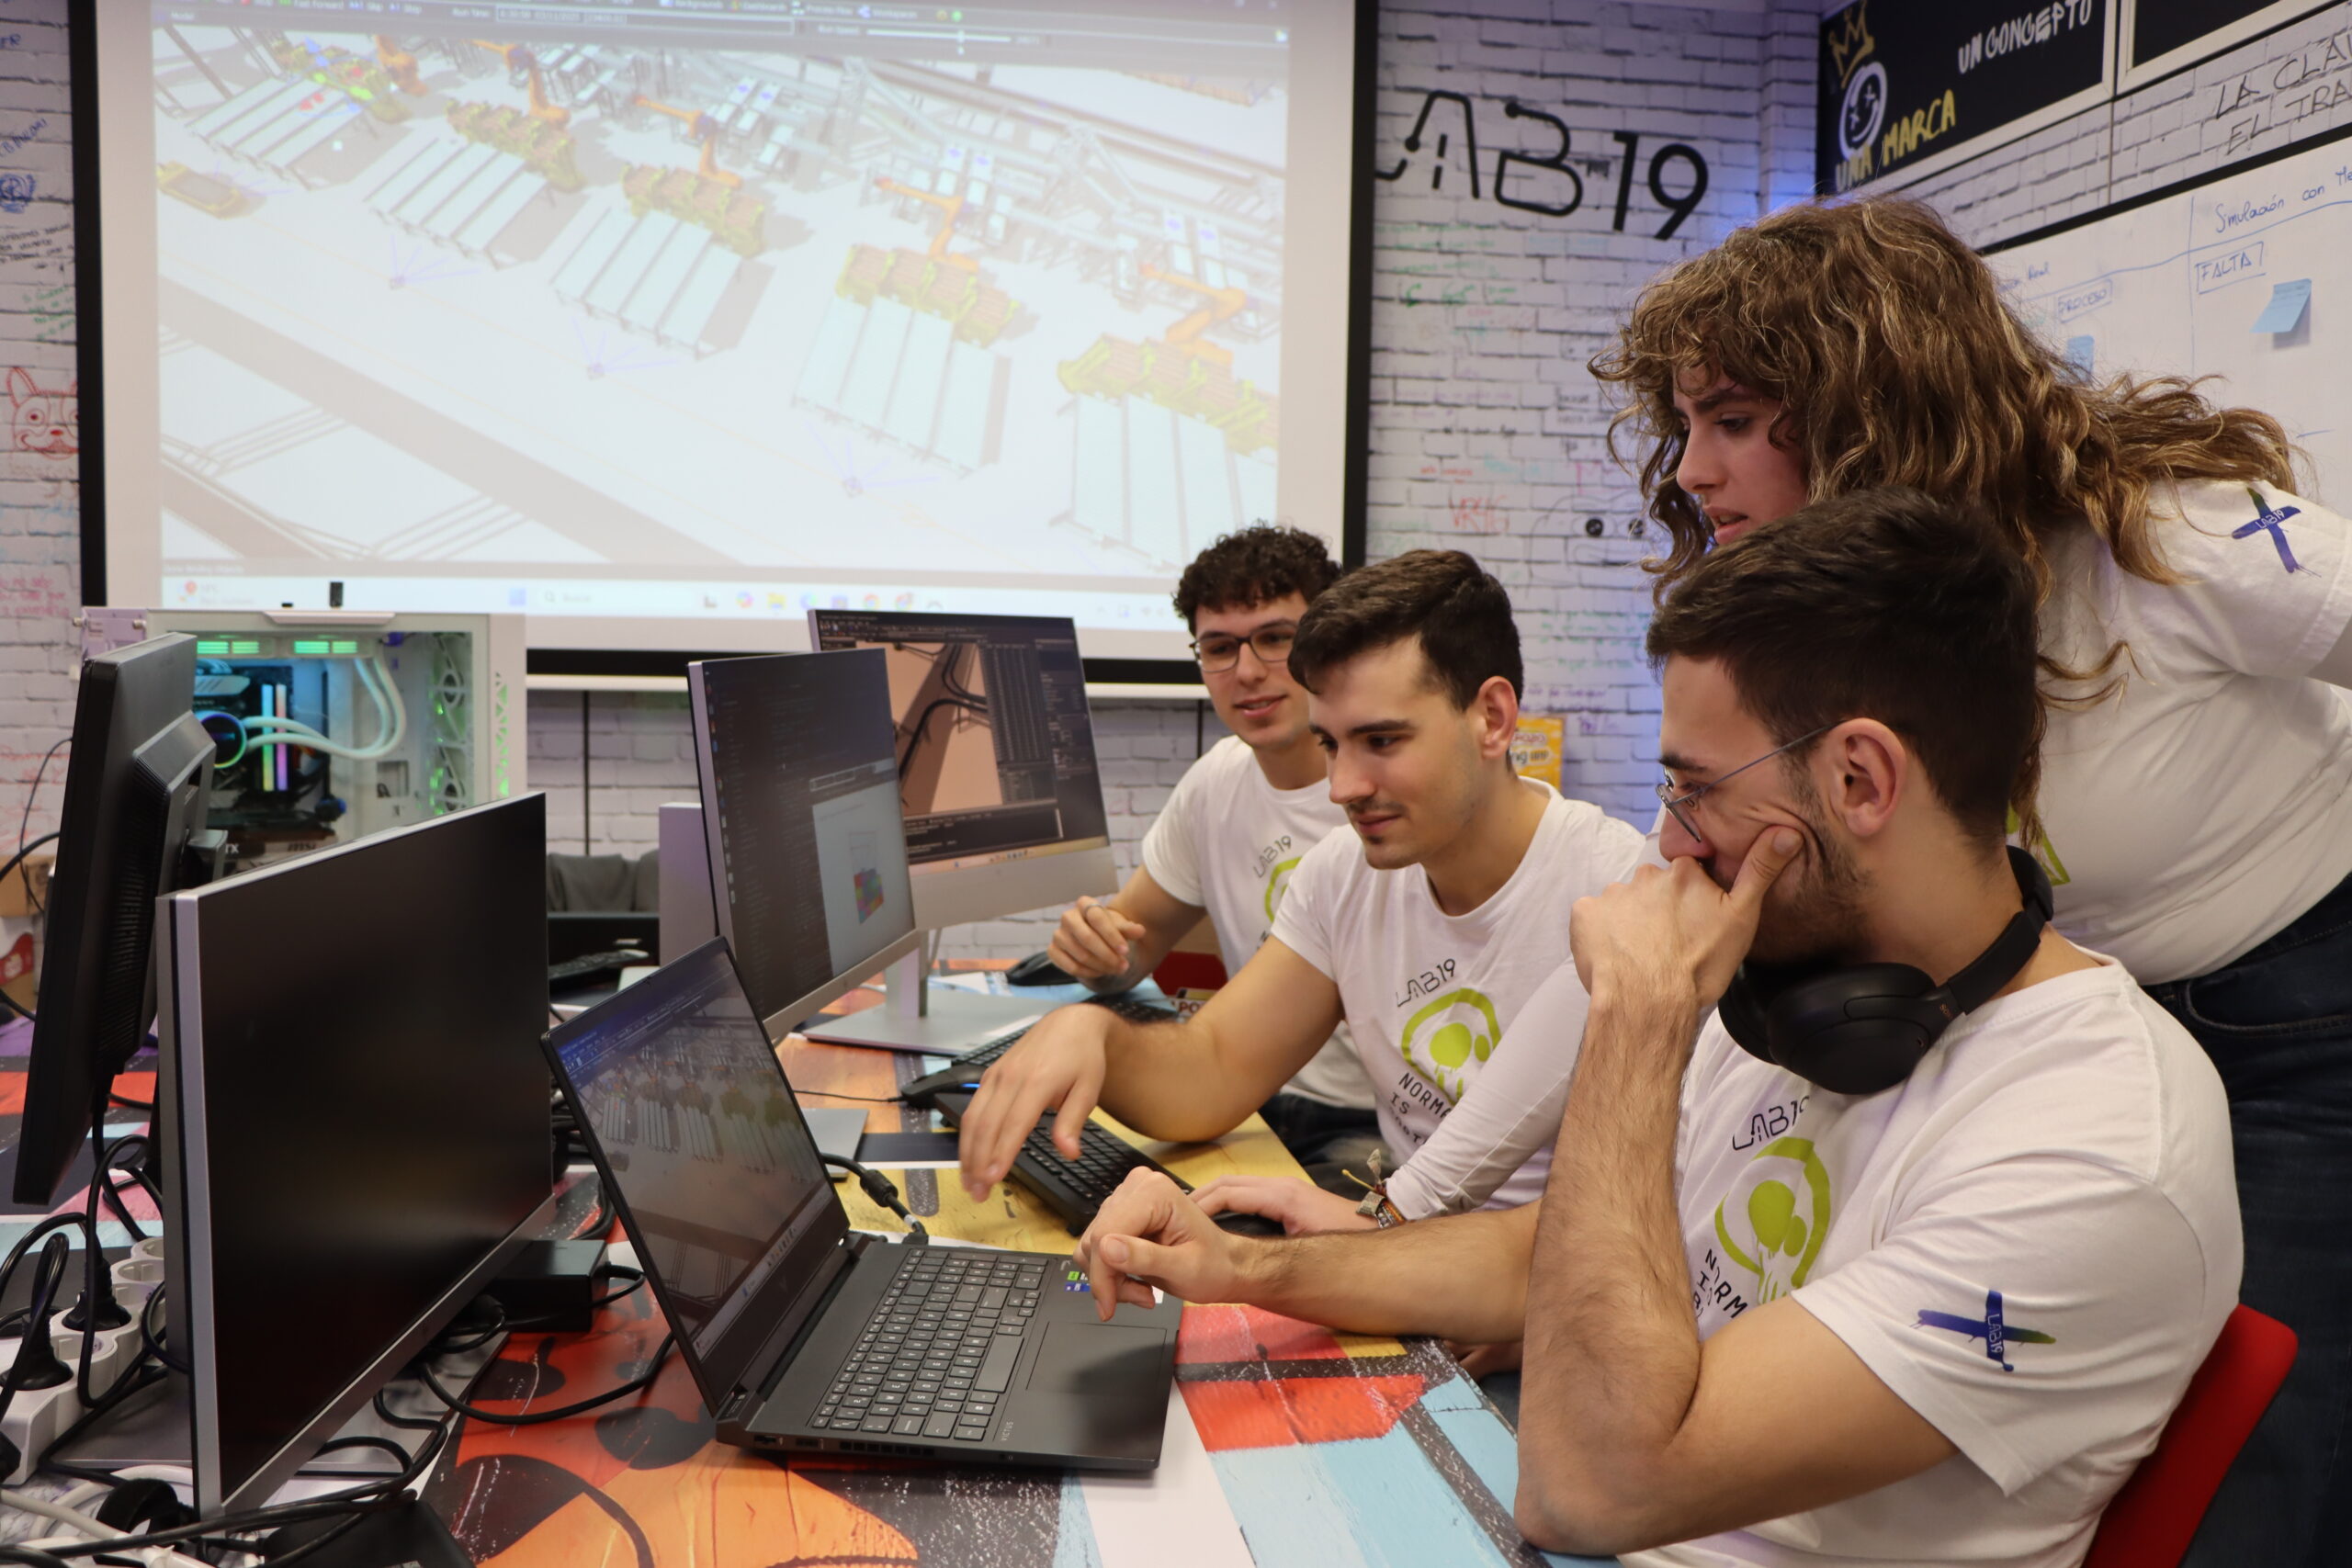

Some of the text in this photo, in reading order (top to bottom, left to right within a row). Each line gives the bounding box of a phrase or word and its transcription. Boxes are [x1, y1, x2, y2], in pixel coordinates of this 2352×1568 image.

[1958, 0, 2092, 74] UN CONCEPTO
[2216, 34, 2352, 119] LA CLA
[1883, 89, 1956, 167] MARCA
[2226, 113, 2273, 155] EL
[2301, 186, 2325, 201] con
[2201, 251, 2252, 280] FALTA
[2255, 509, 2286, 529] LAB19
[1253, 835, 1292, 878] LAB19
[1396, 958, 1456, 1008] LAB19
[1390, 1091, 1410, 1114] IS
[1987, 1314, 2004, 1353] LAB19
